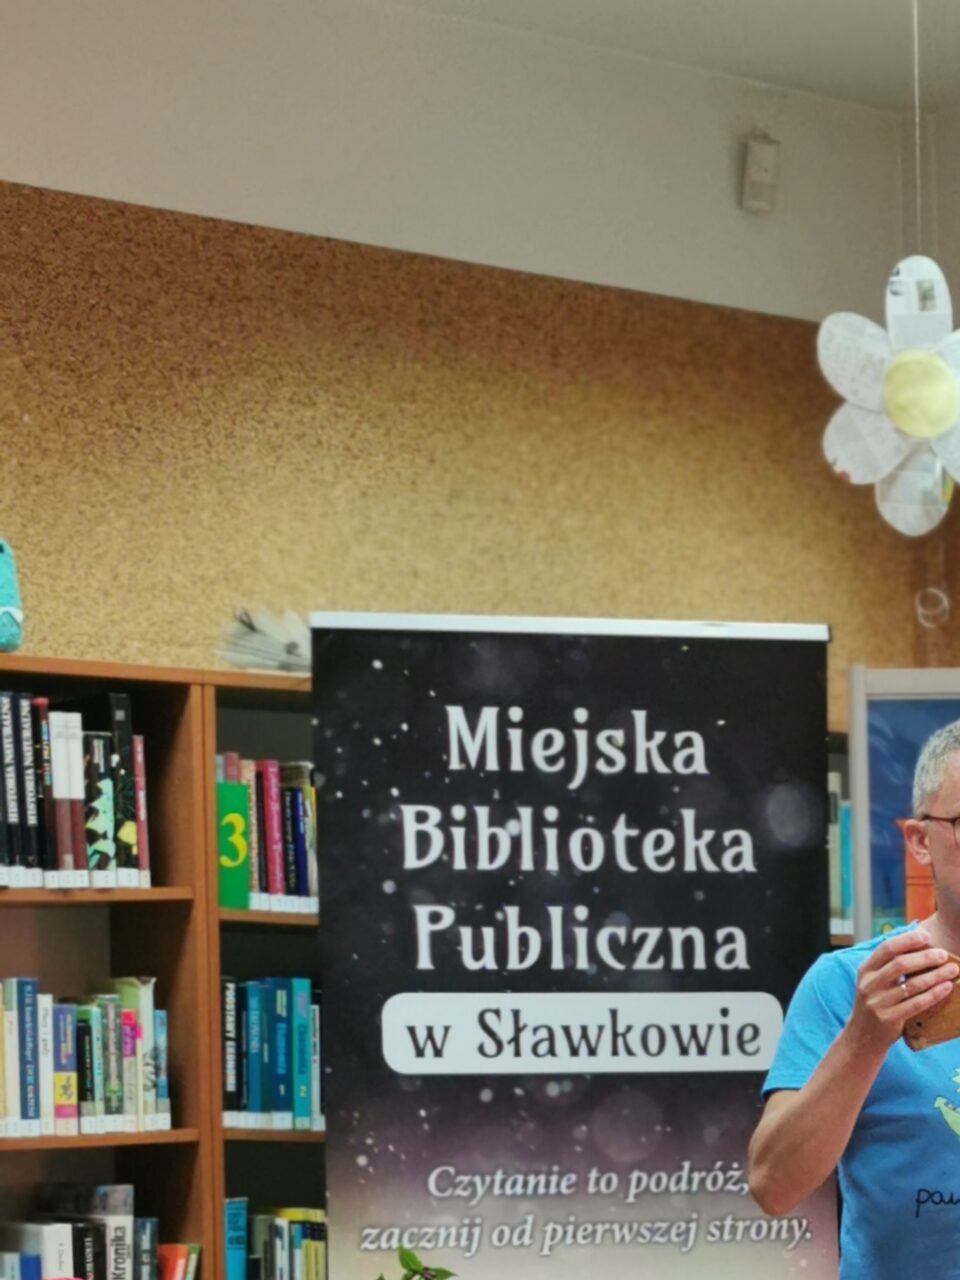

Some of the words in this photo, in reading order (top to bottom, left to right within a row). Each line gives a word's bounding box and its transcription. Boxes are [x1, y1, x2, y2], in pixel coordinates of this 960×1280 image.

[445, 705, 710, 790] Miejska
[220, 813, 248, 868] 3
[400, 804, 757, 872] Biblioteka
[412, 904, 751, 970] Publiczna
[406, 1023, 452, 1058] w
[477, 1008, 761, 1058] Sławkowie
[427, 1165, 577, 1206] Czytanie
[587, 1169, 618, 1195] to
[361, 1216, 482, 1257] zacznij
[491, 1214, 533, 1247] od
[540, 1211, 698, 1256] pierwszej
[707, 1213, 813, 1250] strony.
